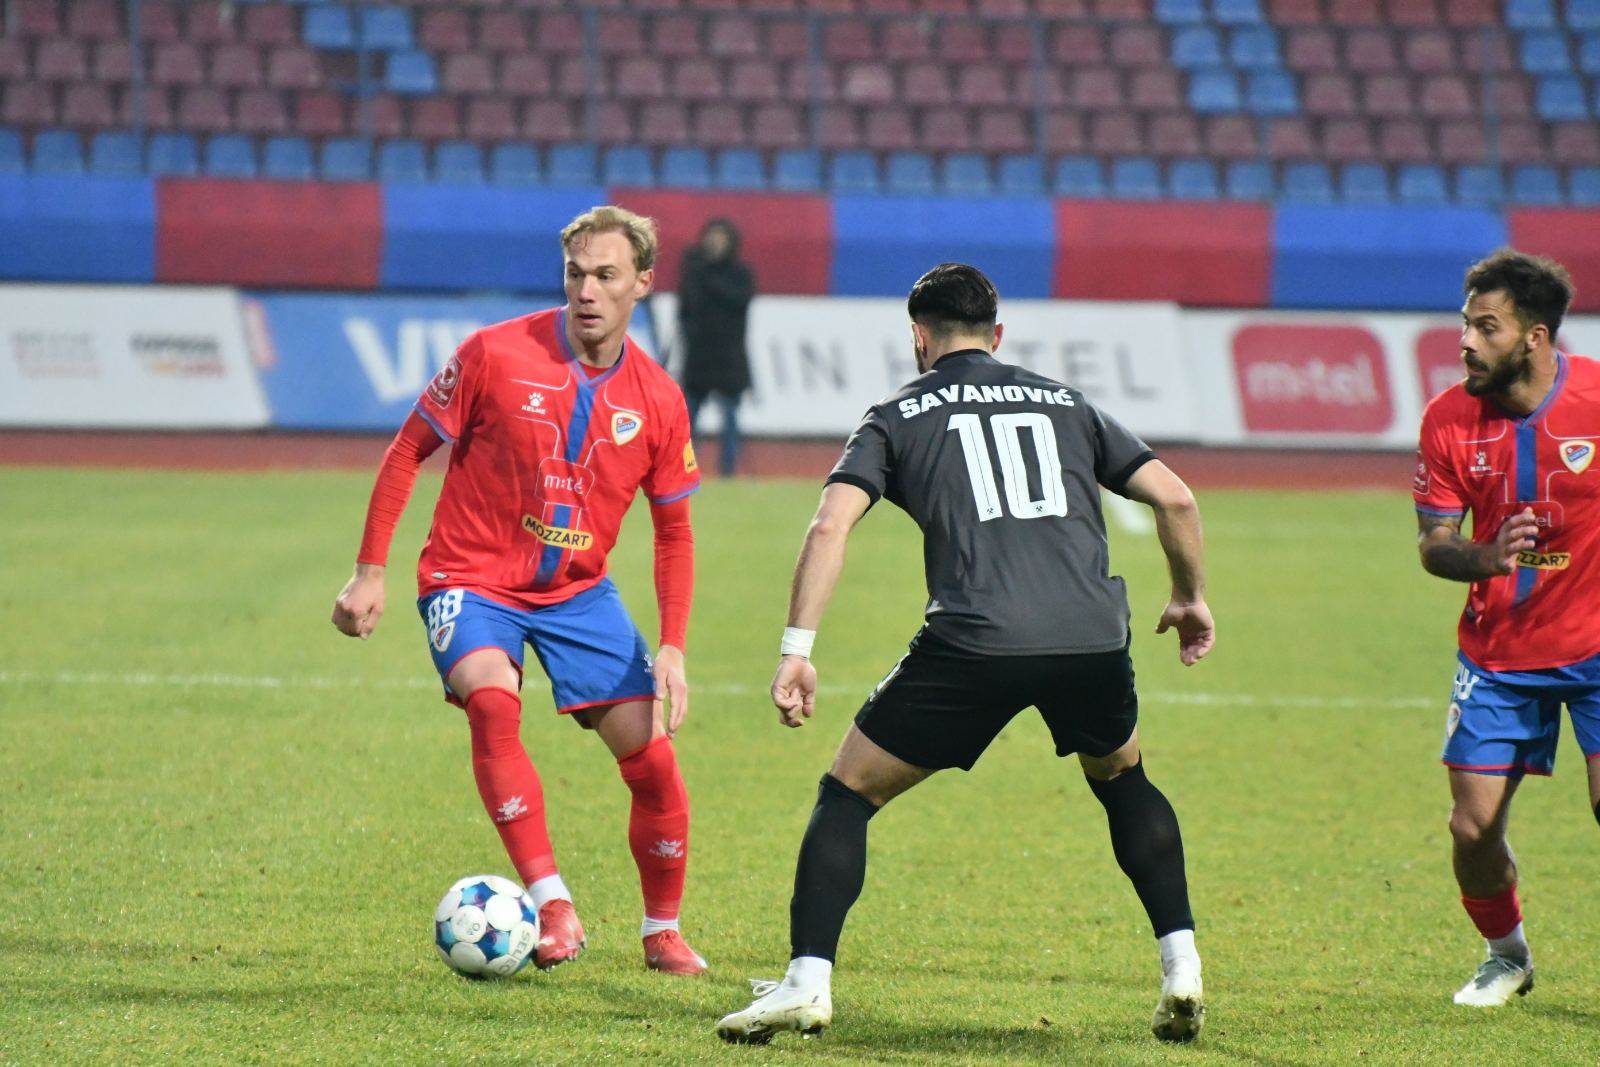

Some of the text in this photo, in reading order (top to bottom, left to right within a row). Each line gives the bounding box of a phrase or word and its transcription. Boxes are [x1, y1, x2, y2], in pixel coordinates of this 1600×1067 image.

[898, 384, 1075, 419] SAVANOVIĆ
[947, 412, 1068, 522] 10
[524, 517, 590, 547] MOZZART
[1517, 552, 1568, 567] ZZART
